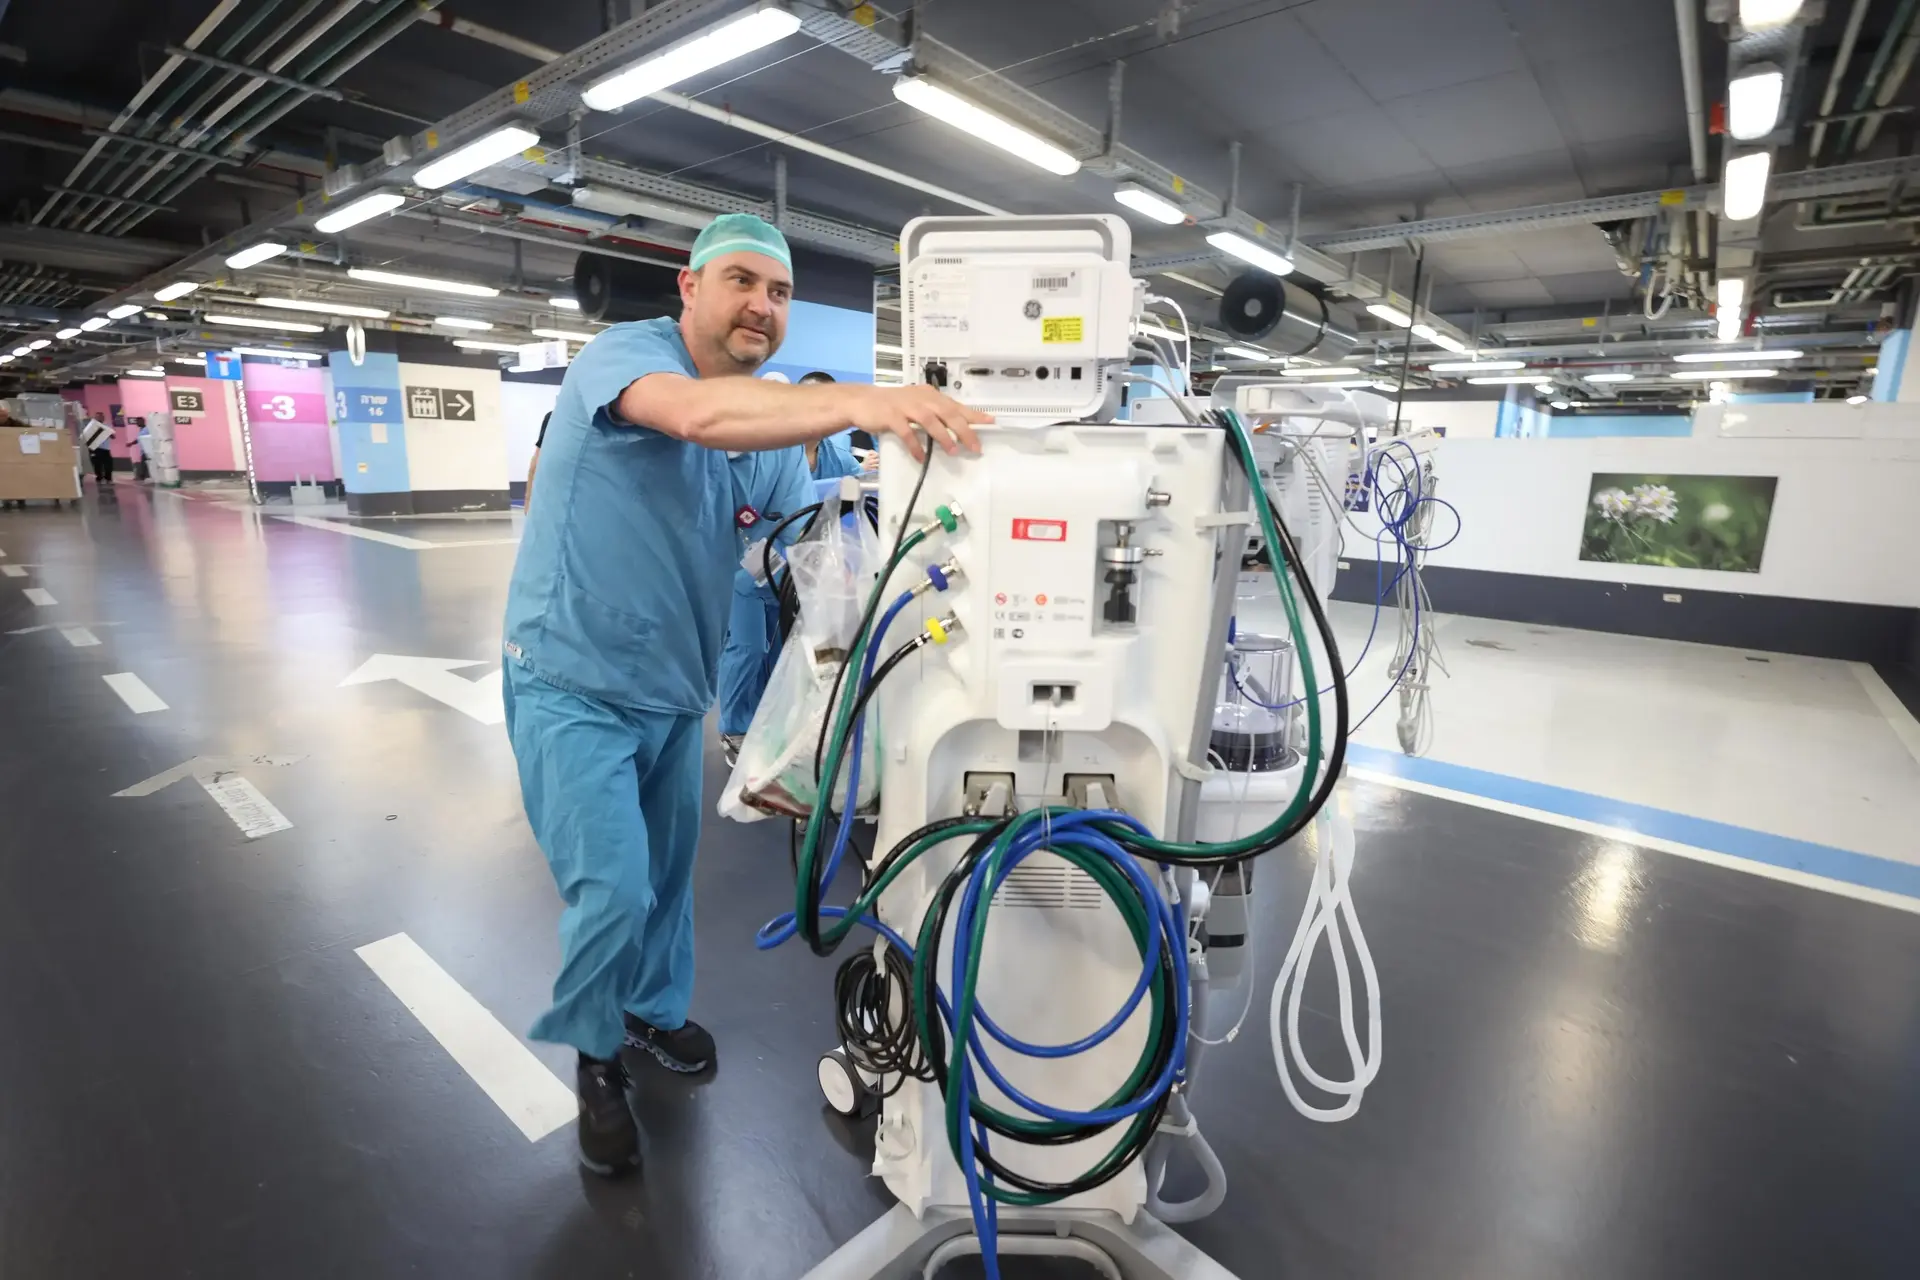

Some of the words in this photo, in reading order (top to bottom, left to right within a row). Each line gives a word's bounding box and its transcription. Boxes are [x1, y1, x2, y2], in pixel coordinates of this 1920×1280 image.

[176, 395, 198, 408] E3
[261, 395, 296, 420] -3
[368, 407, 384, 417] 16
